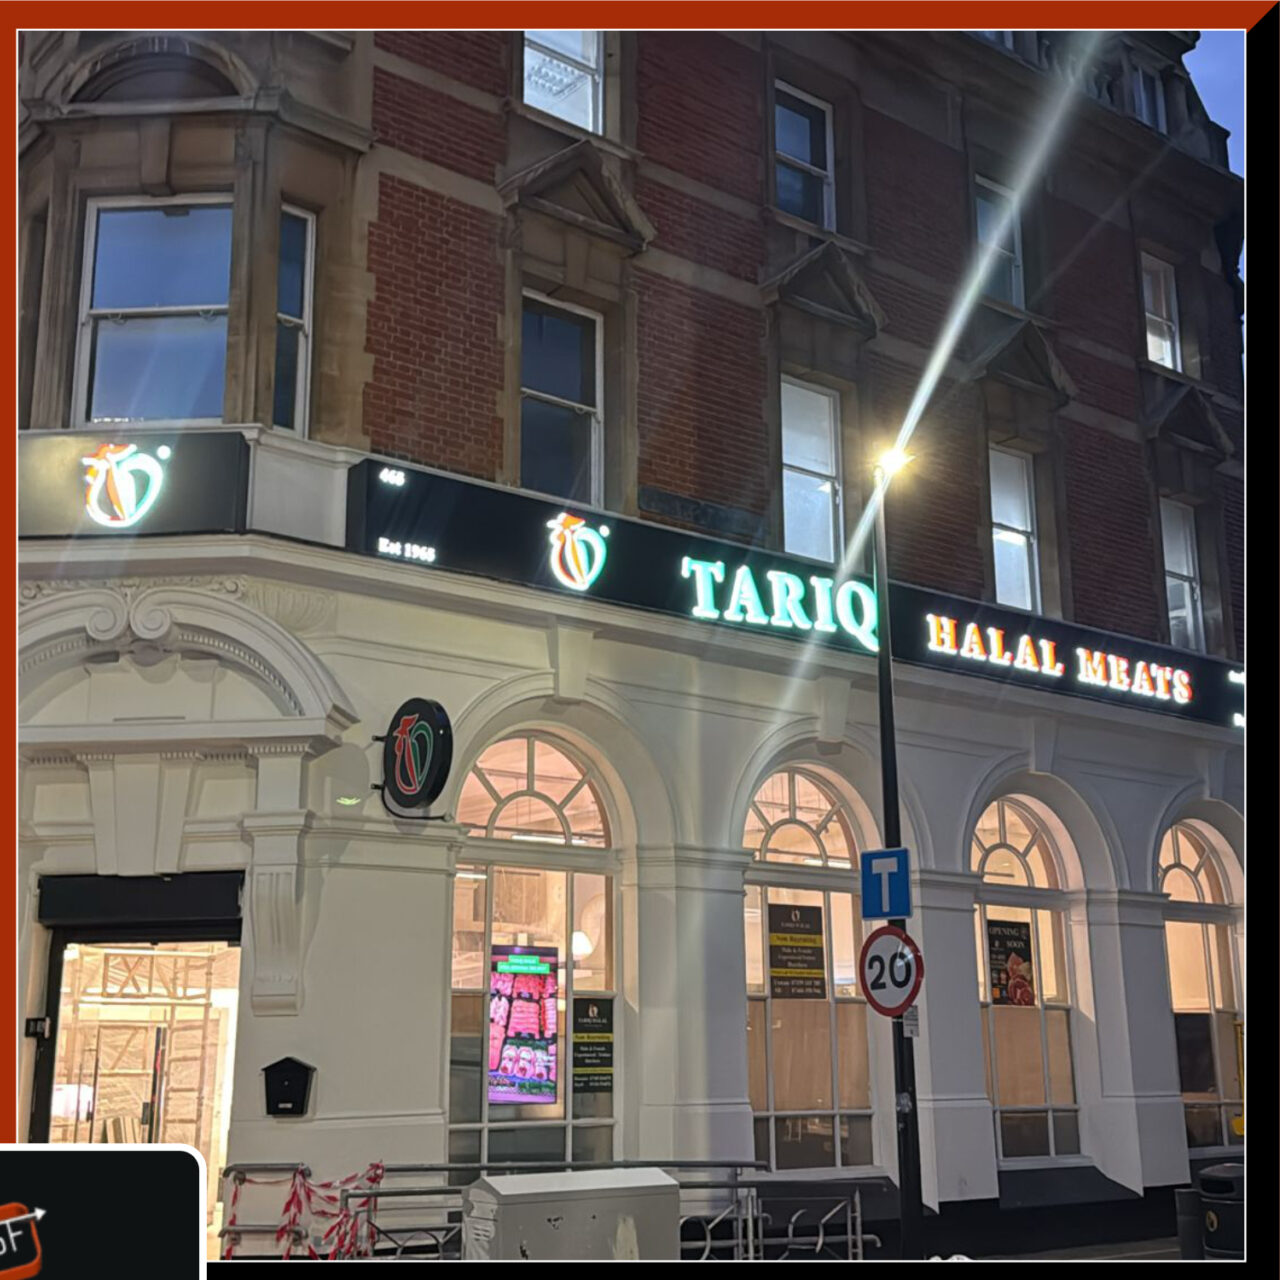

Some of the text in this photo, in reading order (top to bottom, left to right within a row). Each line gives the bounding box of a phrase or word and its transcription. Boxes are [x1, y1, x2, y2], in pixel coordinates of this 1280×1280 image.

[681, 556, 881, 653] TARIQ
[926, 613, 1193, 704] HALAL MEATS
[868, 951, 912, 991] 20
